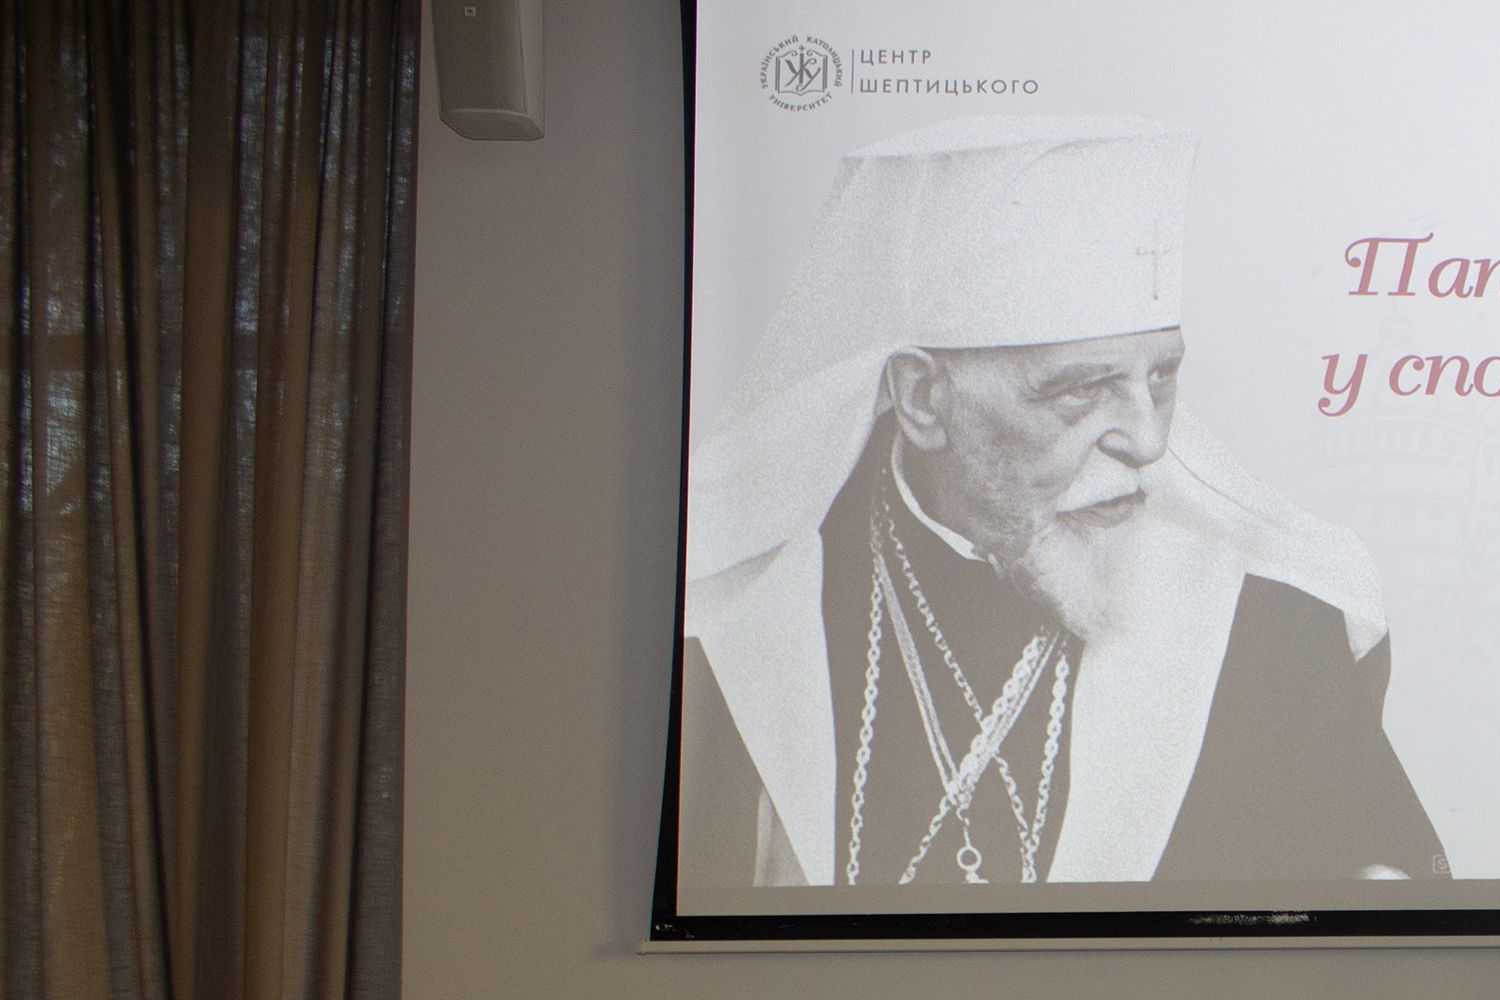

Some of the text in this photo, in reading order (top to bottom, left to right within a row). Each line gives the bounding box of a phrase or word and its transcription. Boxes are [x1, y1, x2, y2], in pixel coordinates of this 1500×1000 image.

[860, 50, 932, 66] ЦЕНТР
[860, 79, 1039, 96] ШЕПТИЦЬКОГО
[1318, 354, 1369, 418] у
